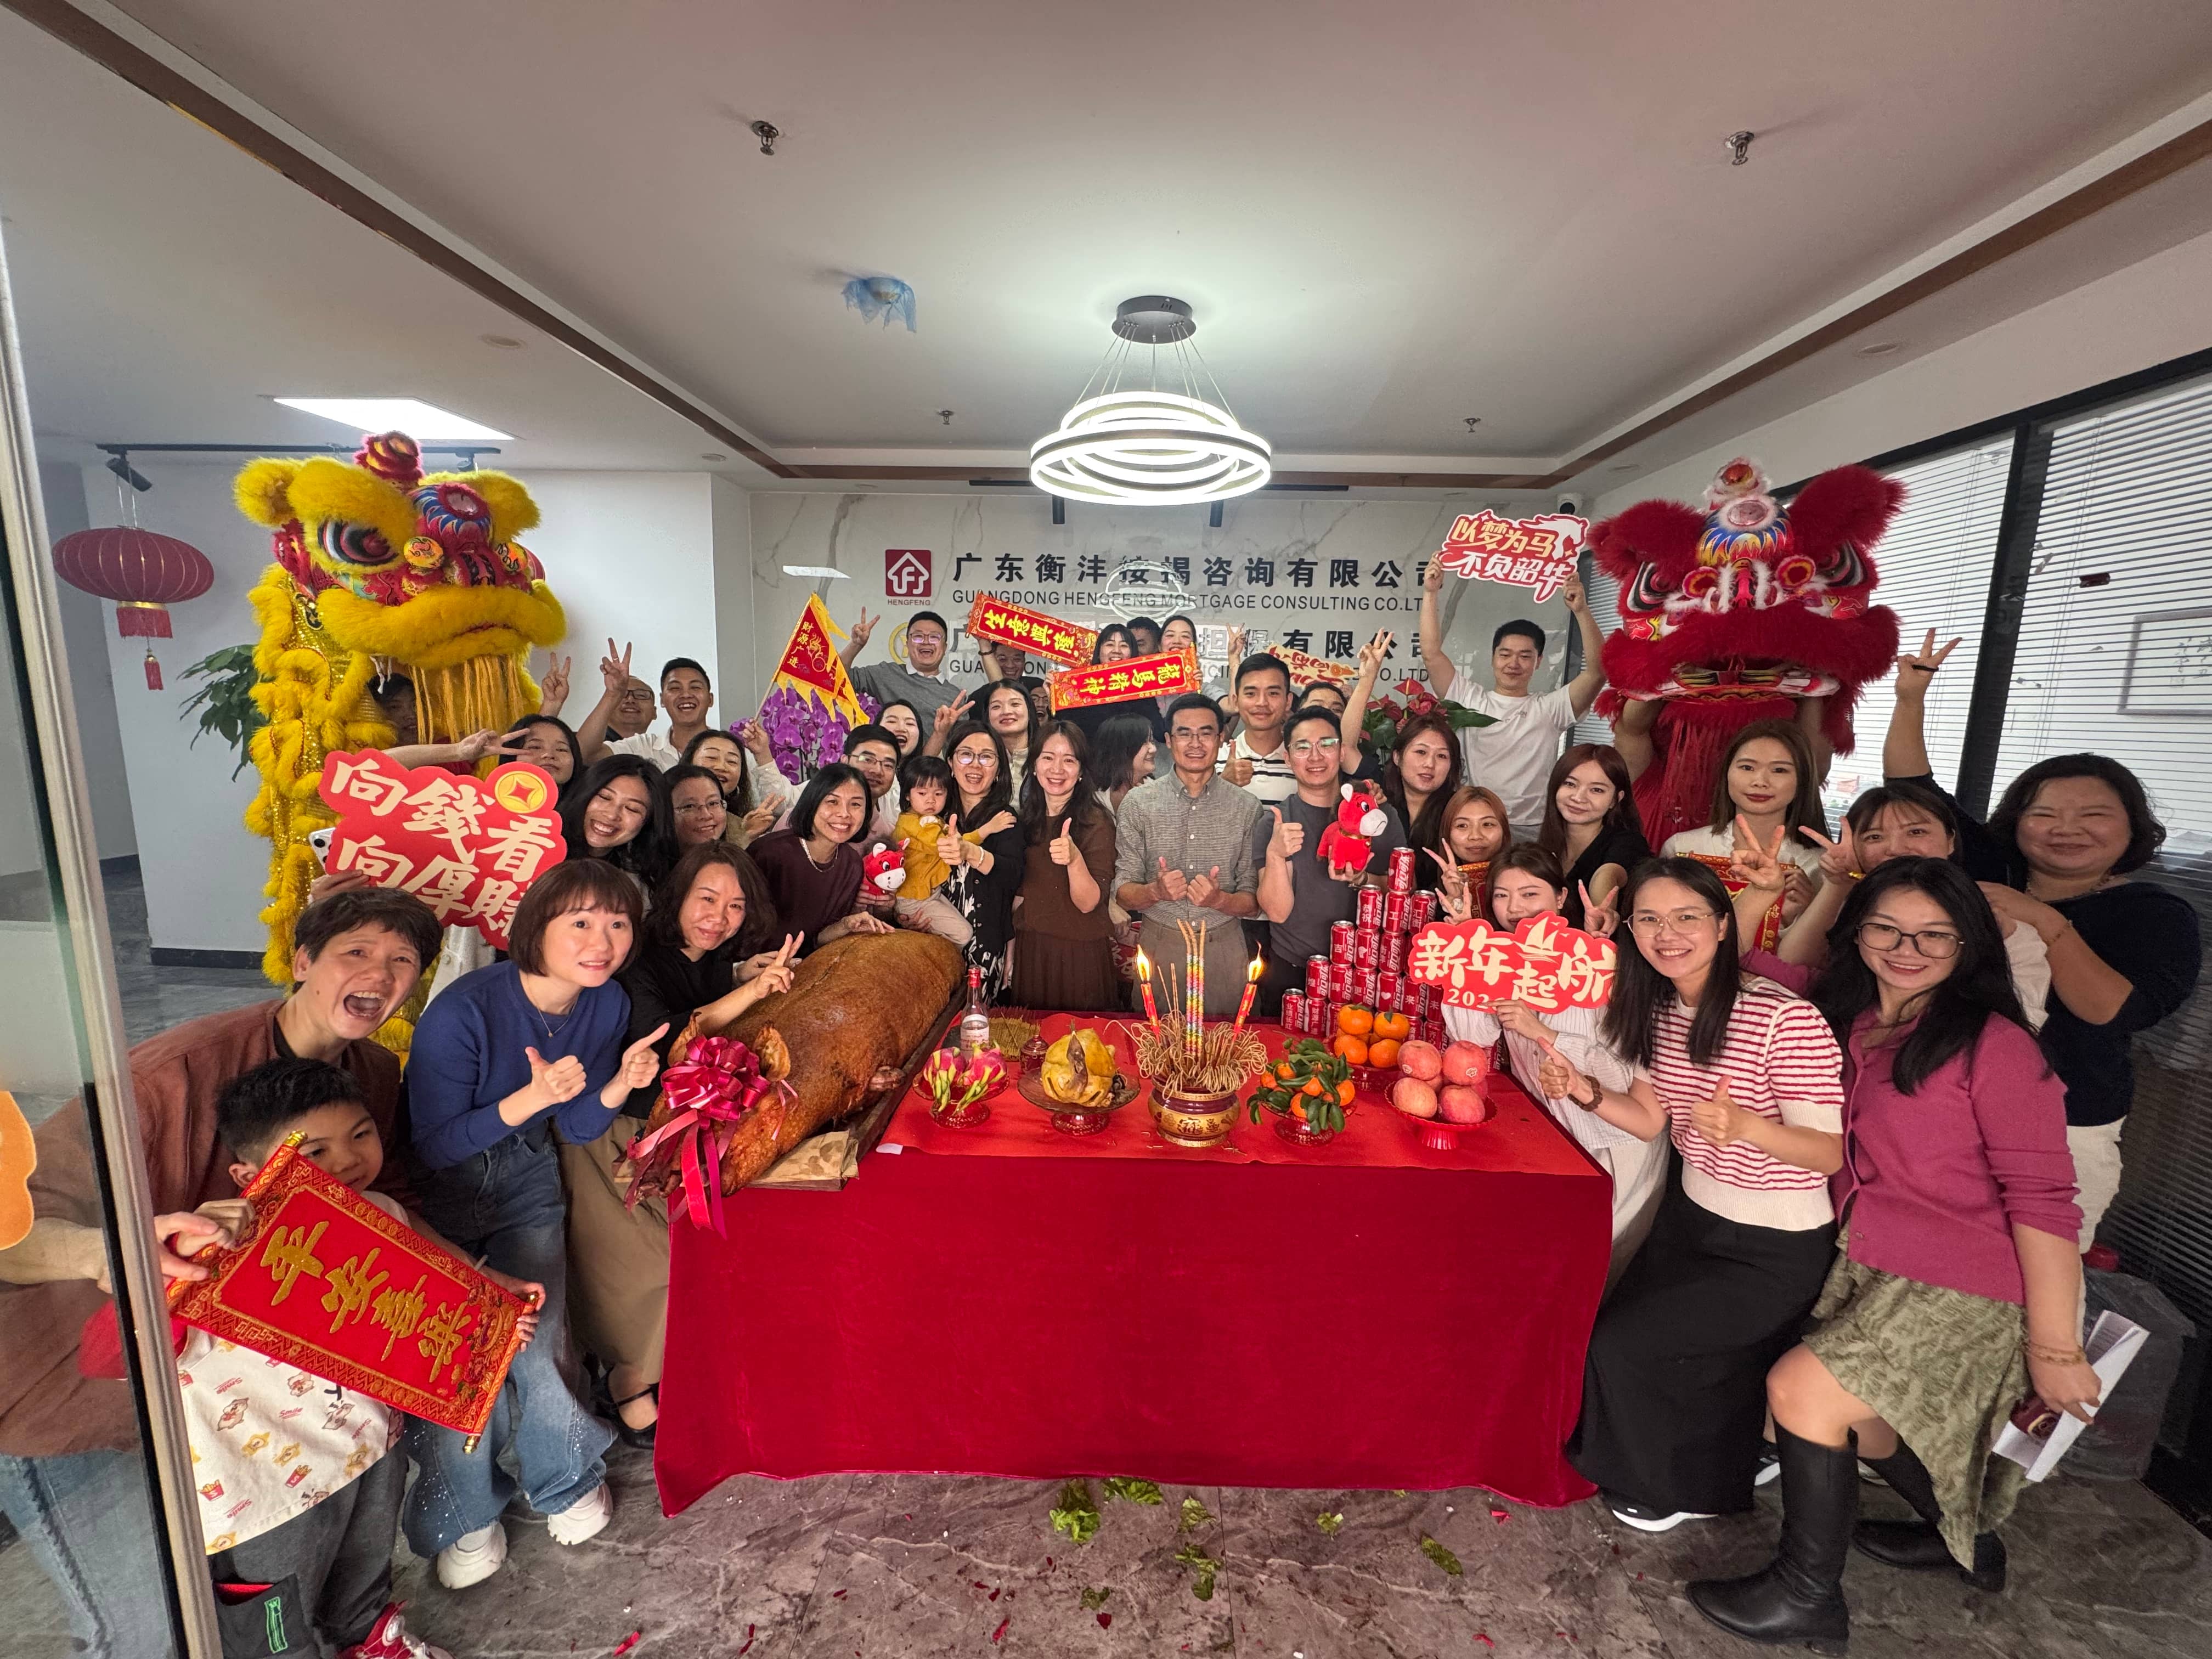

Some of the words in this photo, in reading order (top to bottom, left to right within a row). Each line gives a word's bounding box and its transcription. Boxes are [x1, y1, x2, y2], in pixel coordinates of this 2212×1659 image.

[1448, 518, 1555, 558] 以梦为马
[1443, 550, 1572, 598] 不负韶华
[953, 590, 1059, 605] GUNGDONG
[1162, 593, 1256, 608] MORTGAGE
[1262, 595, 1370, 611] CONSULTING
[787, 621, 814, 668] 财源广进
[1079, 662, 1181, 695] 龍馬精神
[330, 758, 556, 883] 向錢看
[1414, 924, 1617, 1008] 新年起航
[279, 1407, 303, 1417] Smile
